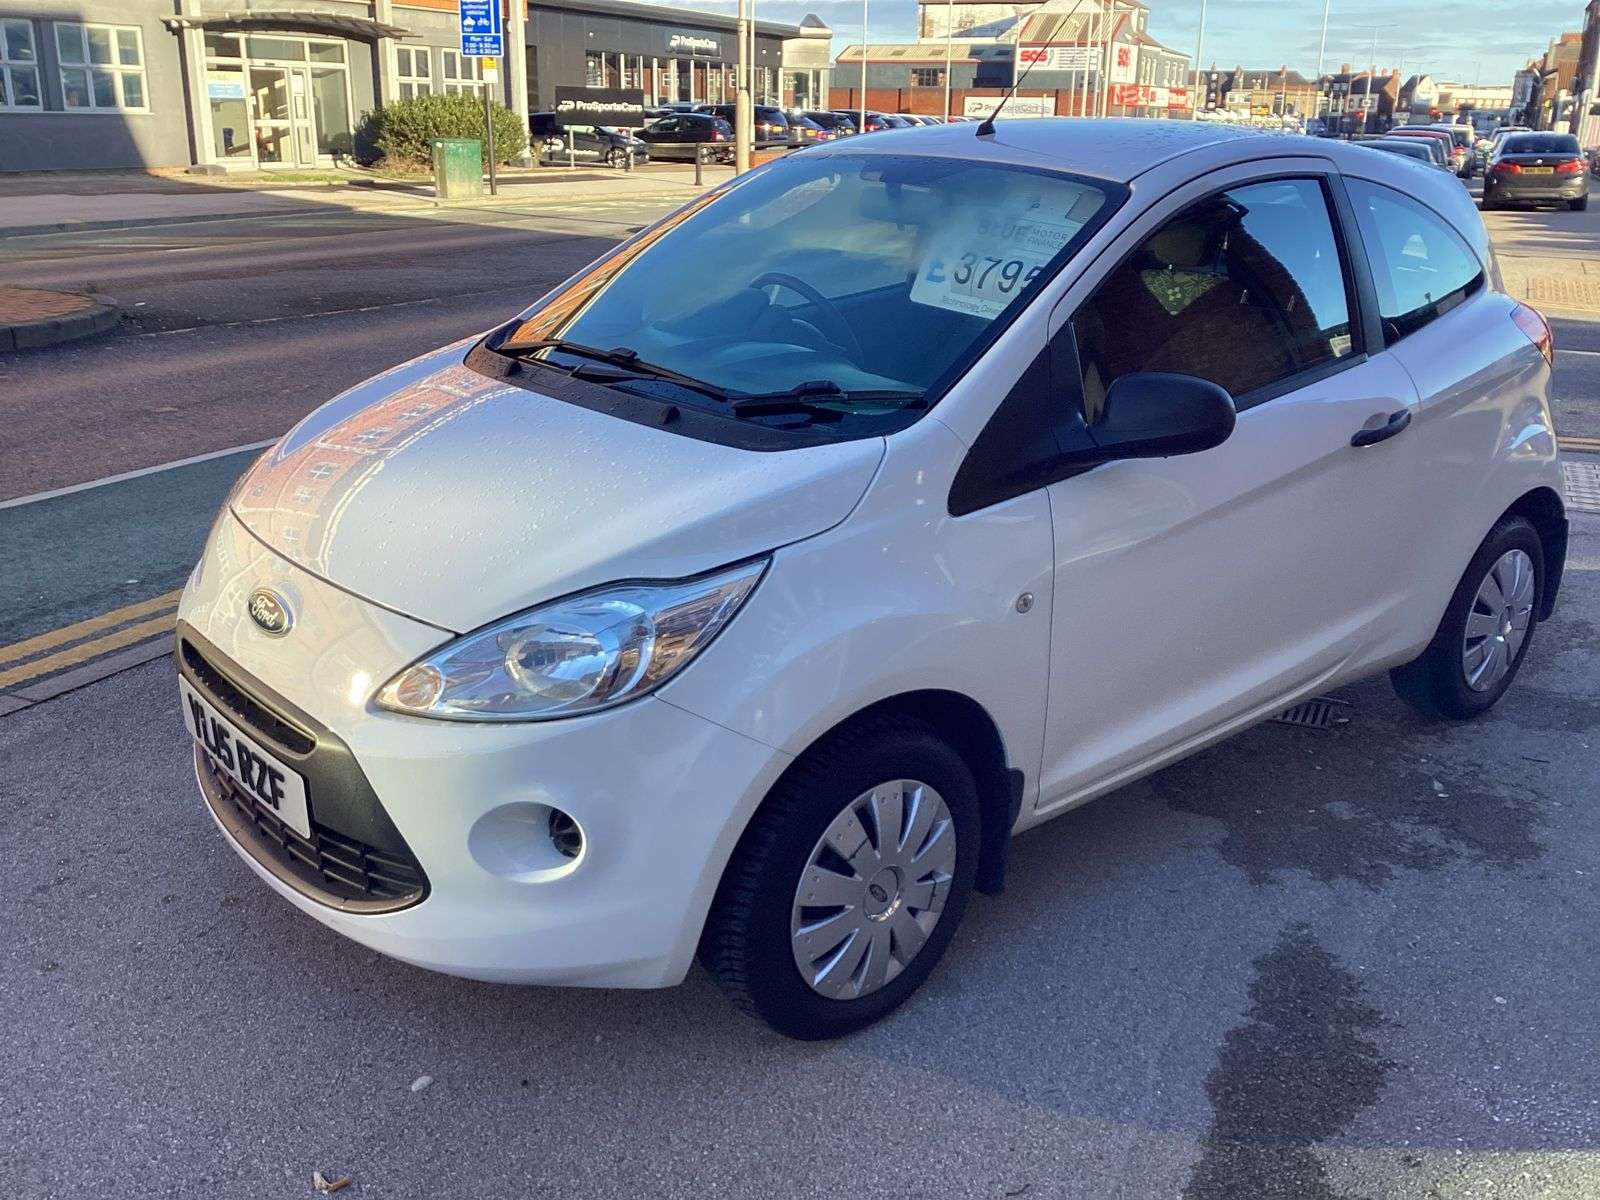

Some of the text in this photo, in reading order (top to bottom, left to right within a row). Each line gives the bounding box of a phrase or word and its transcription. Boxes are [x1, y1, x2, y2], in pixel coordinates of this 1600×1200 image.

[576, 101, 643, 113] ProSportsCars
[251, 595, 279, 627] Ford
[236, 739, 285, 811] RZF
